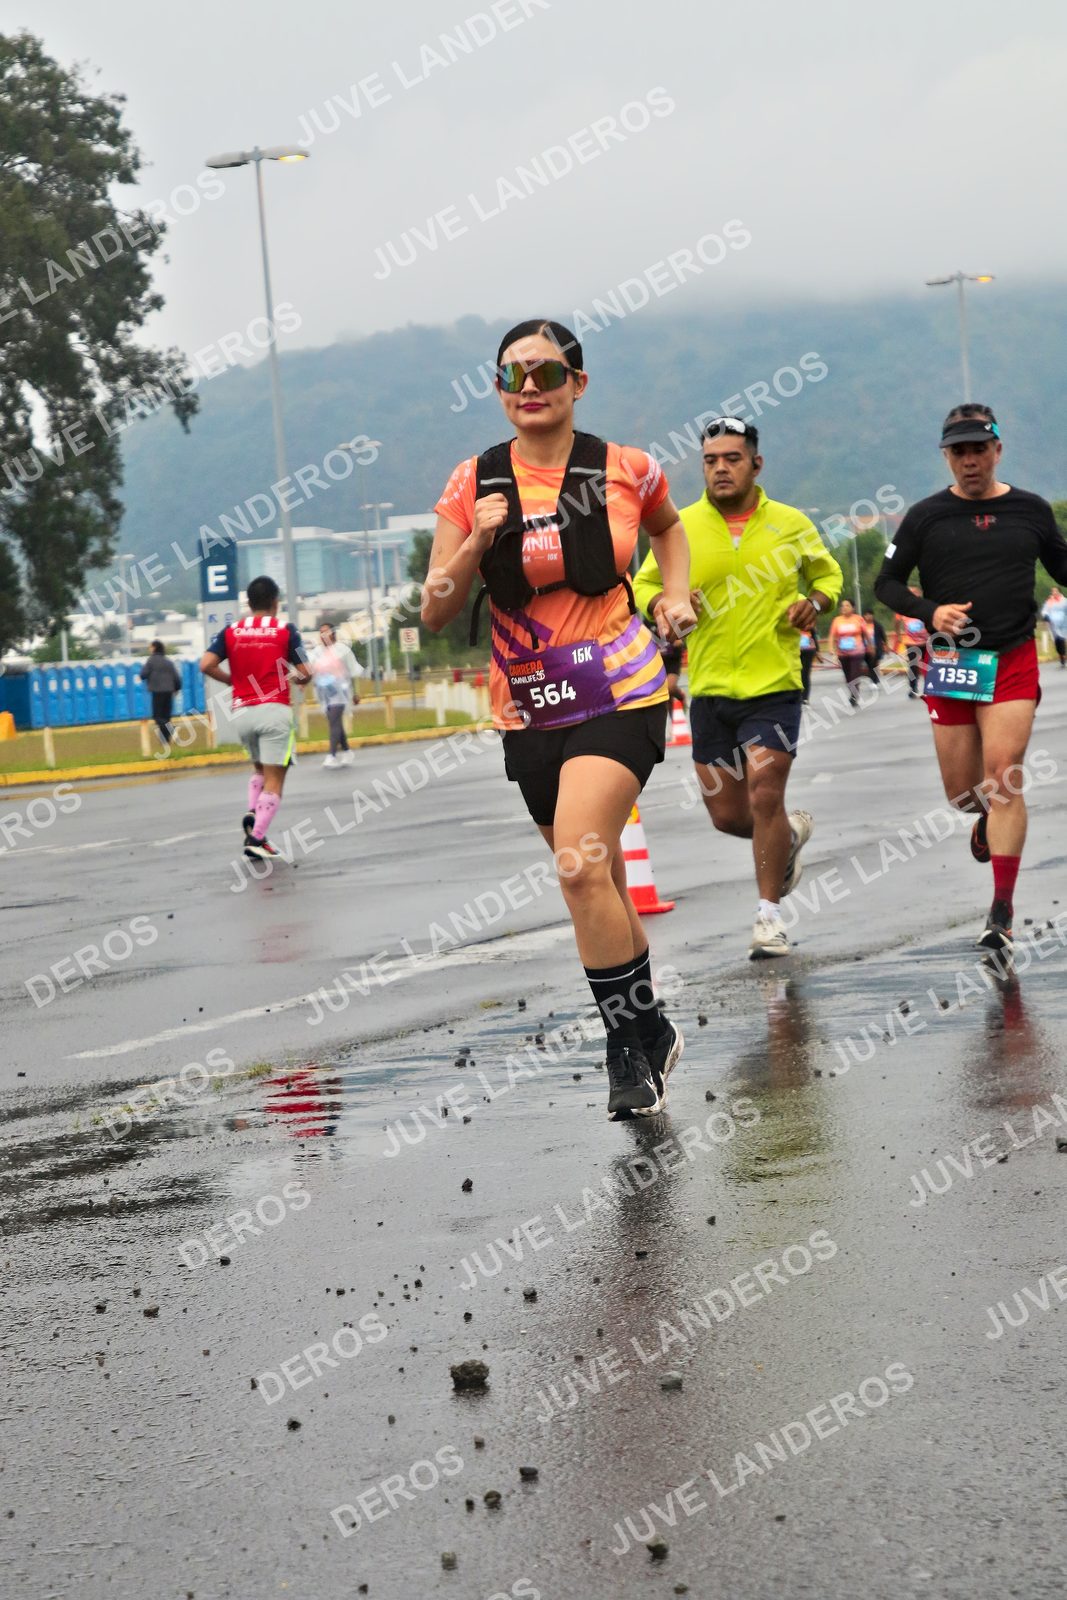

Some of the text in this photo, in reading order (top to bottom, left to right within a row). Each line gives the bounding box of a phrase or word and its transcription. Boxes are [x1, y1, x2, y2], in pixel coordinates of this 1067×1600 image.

[207, 564, 229, 594] E
[233, 627, 278, 637] OMNILIFE
[508, 659, 544, 677] CARRERA
[938, 667, 978, 685] 1353
[530, 680, 576, 708] 564
